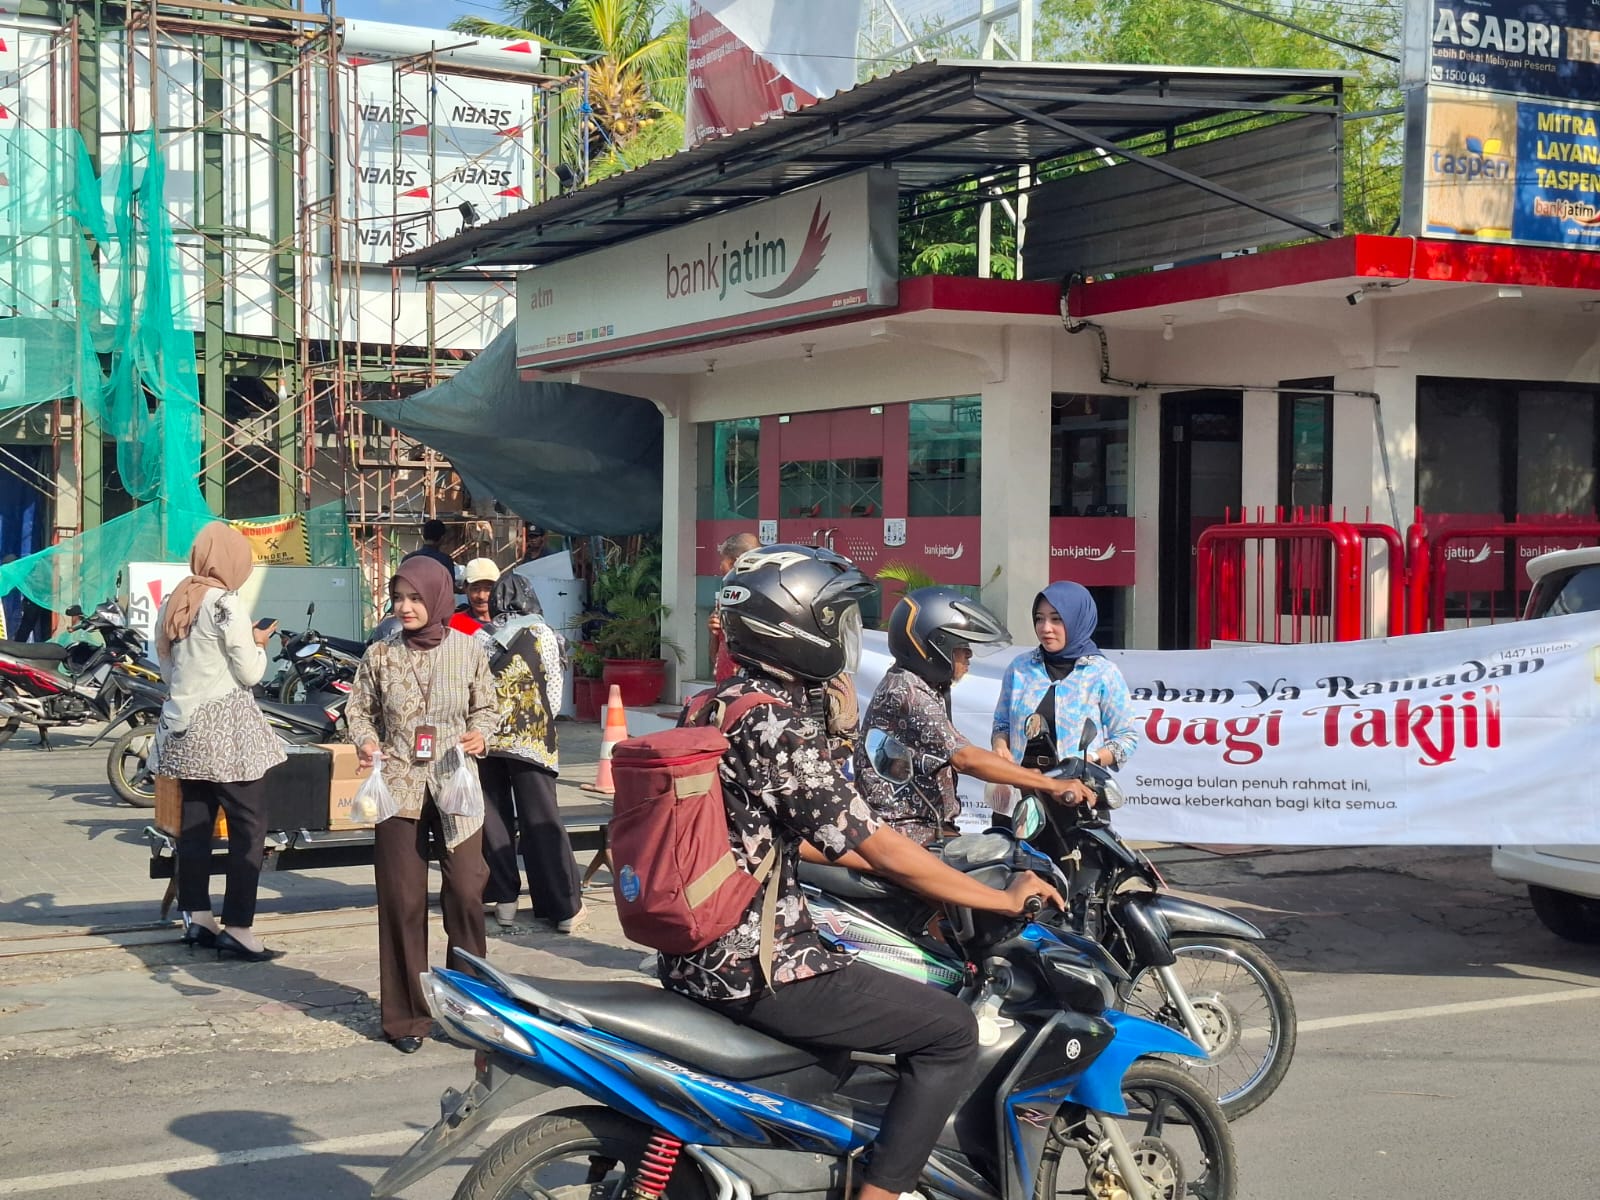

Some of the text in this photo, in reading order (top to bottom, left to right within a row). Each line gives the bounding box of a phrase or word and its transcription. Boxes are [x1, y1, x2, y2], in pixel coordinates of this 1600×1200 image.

[1433, 8, 1560, 58] ASABRI
[1432, 47, 1457, 59] Lebih
[1485, 54, 1522, 69] Melayani
[1524, 60, 1557, 73] Peserta
[1445, 69, 1486, 85] 1500 043
[452, 105, 512, 126] SEVEN
[1538, 112, 1597, 137] MITRA
[452, 166, 512, 187] SEVEN
[1432, 150, 1509, 181] taspen
[1536, 168, 1600, 193] TASPEN
[1534, 197, 1595, 220] bankjatim
[666, 231, 787, 302] bankjatim
[530, 287, 553, 311] atm
[257, 551, 288, 561] UNDER
[1051, 544, 1101, 558] bankjatim
[723, 589, 741, 600] GM
[1500, 648, 1526, 661] 1447
[1131, 657, 1545, 708] aban Ya Ramadan
[1135, 684, 1501, 767] bagi Takjil
[1135, 775, 1371, 793] Semoga bulan penuh rahmat ini,
[1185, 793, 1272, 808] keberkahan
[1276, 794, 1309, 811] bagi
[1313, 795, 1341, 810] kita
[1345, 798, 1398, 810] semua.
